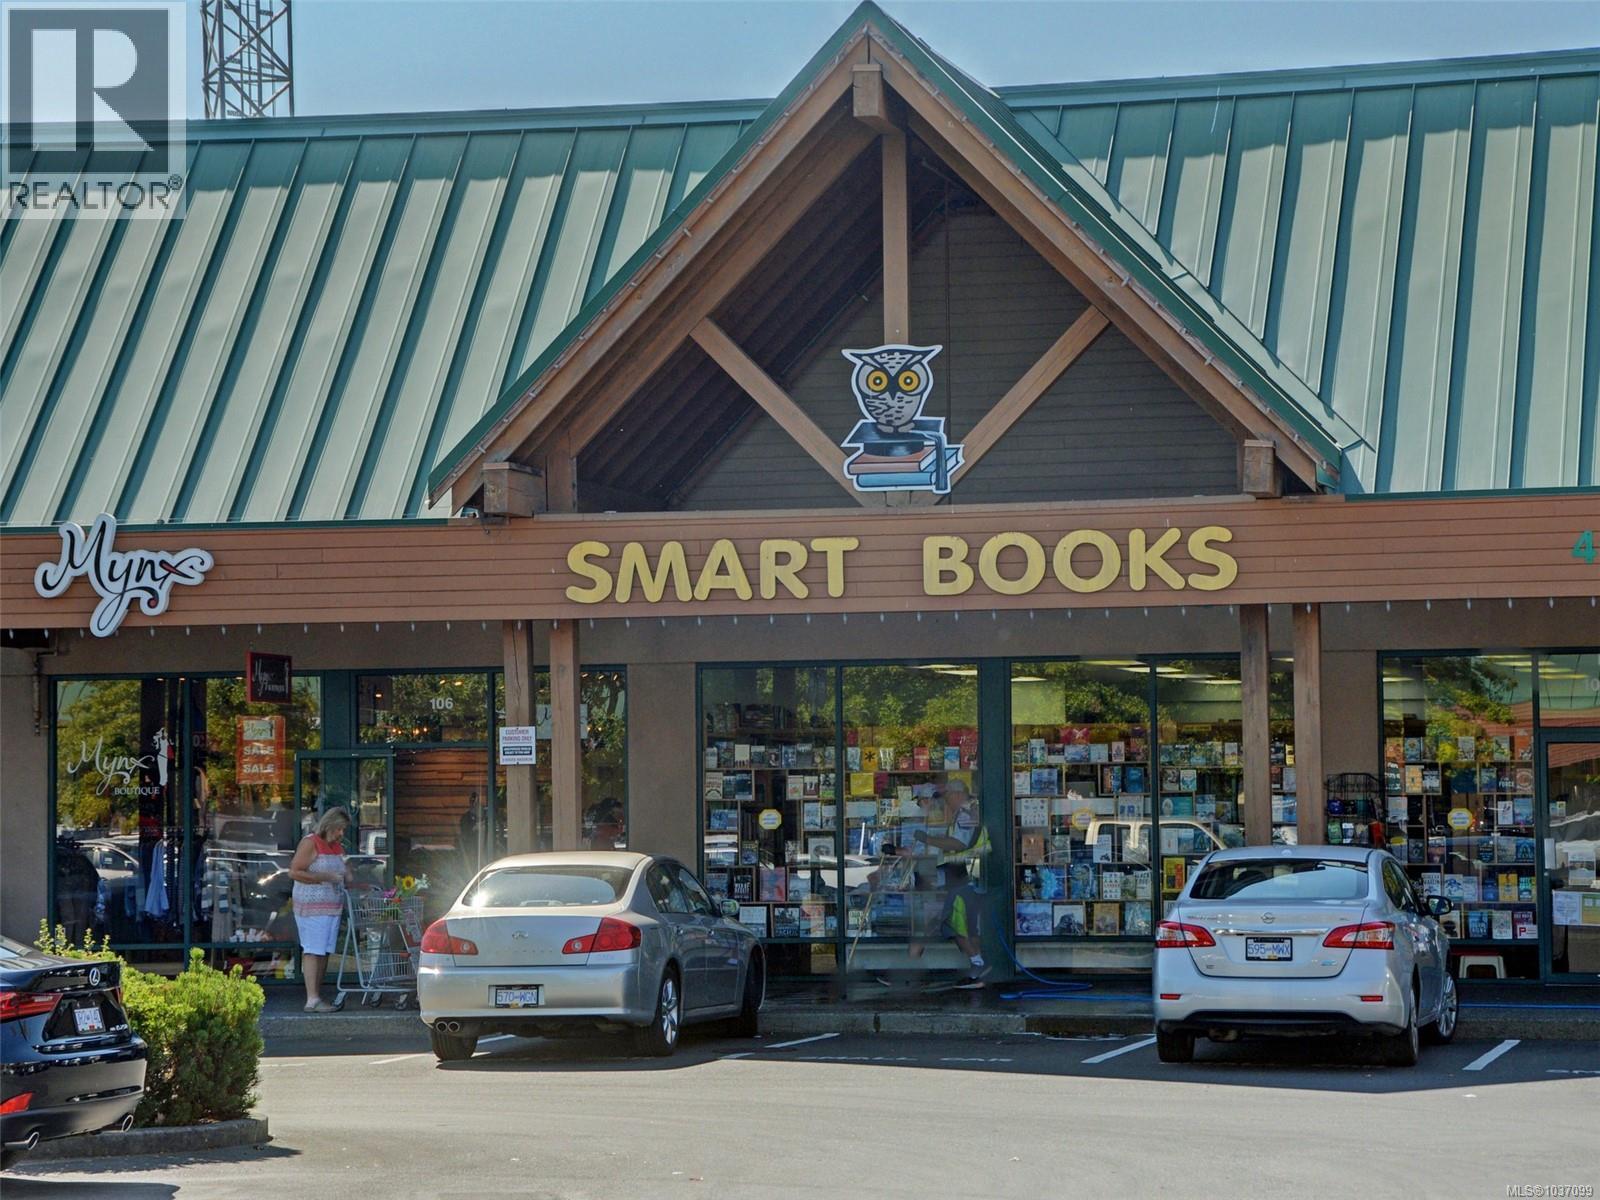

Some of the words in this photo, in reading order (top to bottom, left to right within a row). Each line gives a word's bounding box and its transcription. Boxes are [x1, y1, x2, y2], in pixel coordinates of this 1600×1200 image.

[1571, 530, 1598, 564] 4
[41, 520, 206, 632] Mynx
[565, 536, 860, 604] SMART
[922, 525, 1239, 596] BOOKS
[429, 697, 454, 710] 106
[243, 745, 275, 755] SALE
[66, 735, 156, 796] Mynx
[243, 763, 275, 773] SALE
[113, 786, 160, 795] BOUTIQUE
